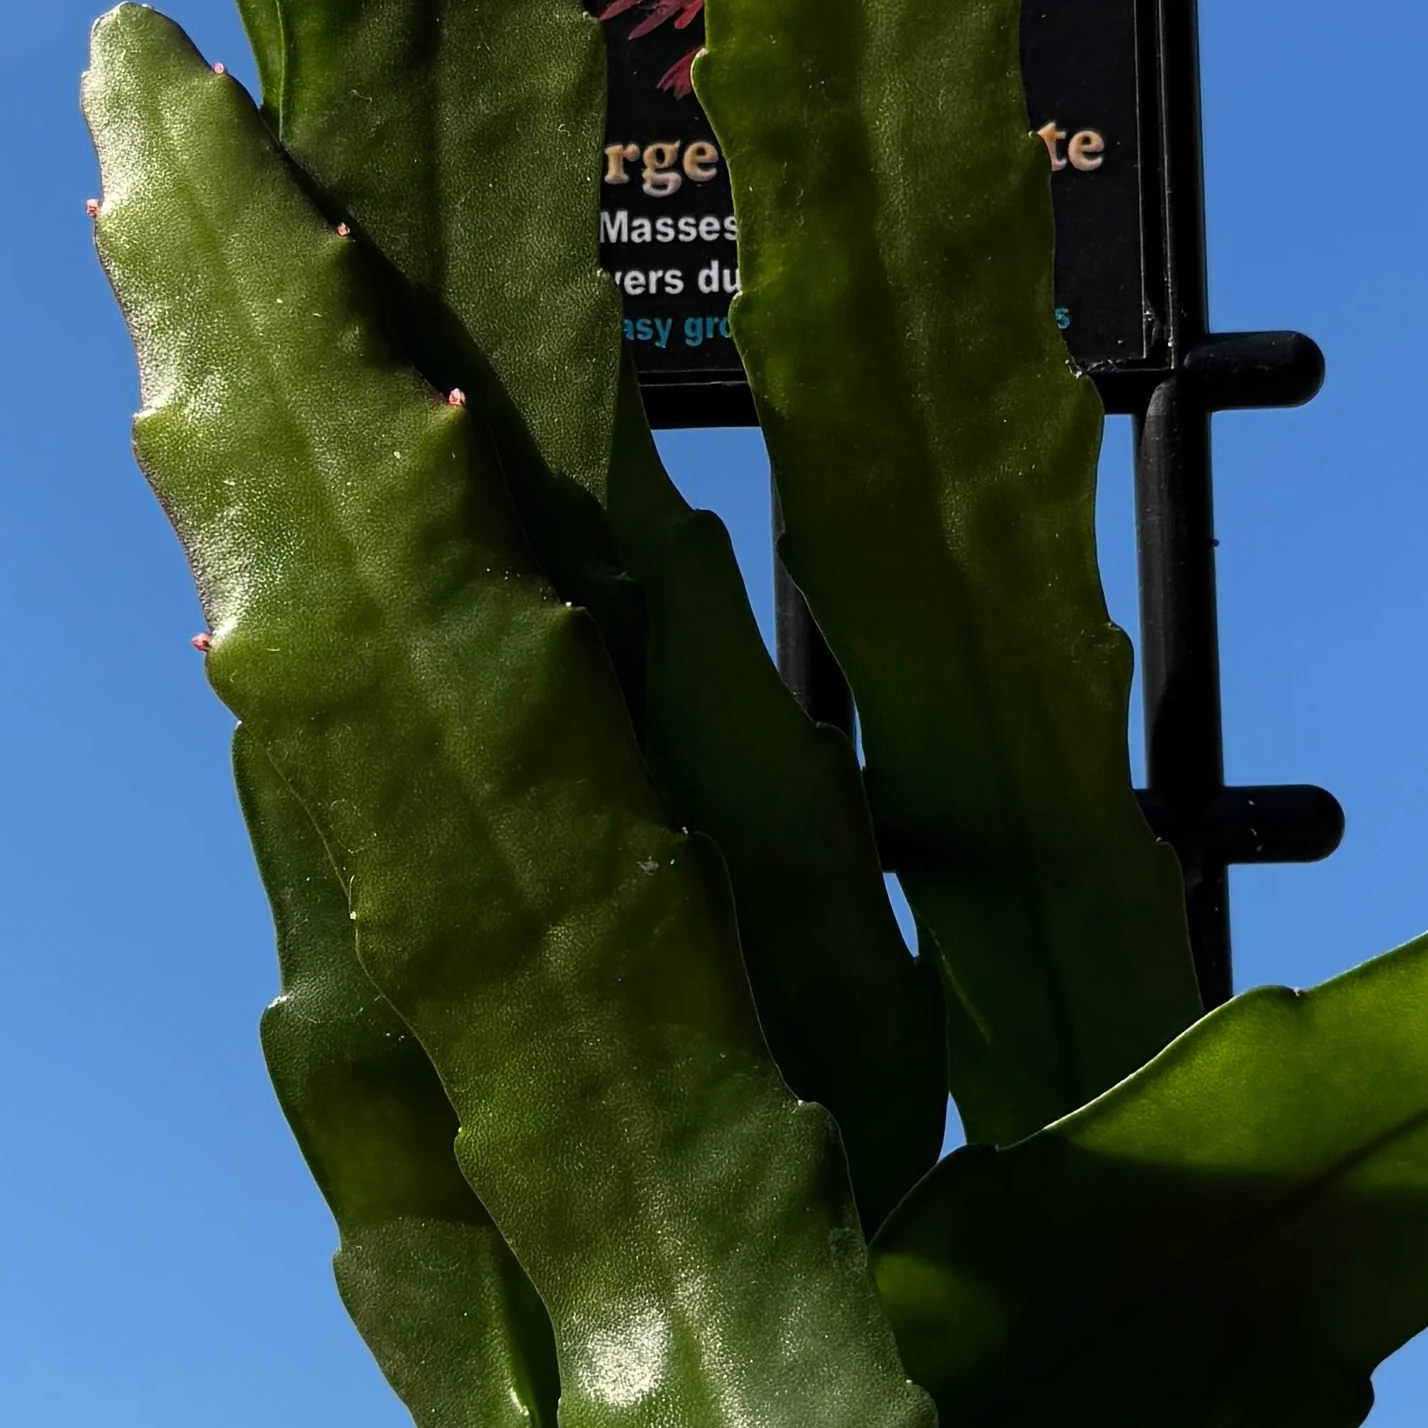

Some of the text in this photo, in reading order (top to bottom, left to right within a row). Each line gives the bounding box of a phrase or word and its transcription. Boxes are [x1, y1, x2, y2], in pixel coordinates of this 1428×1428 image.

[604, 140, 720, 198] rge
[600, 210, 739, 243] Masses
[624, 317, 672, 348] asy
